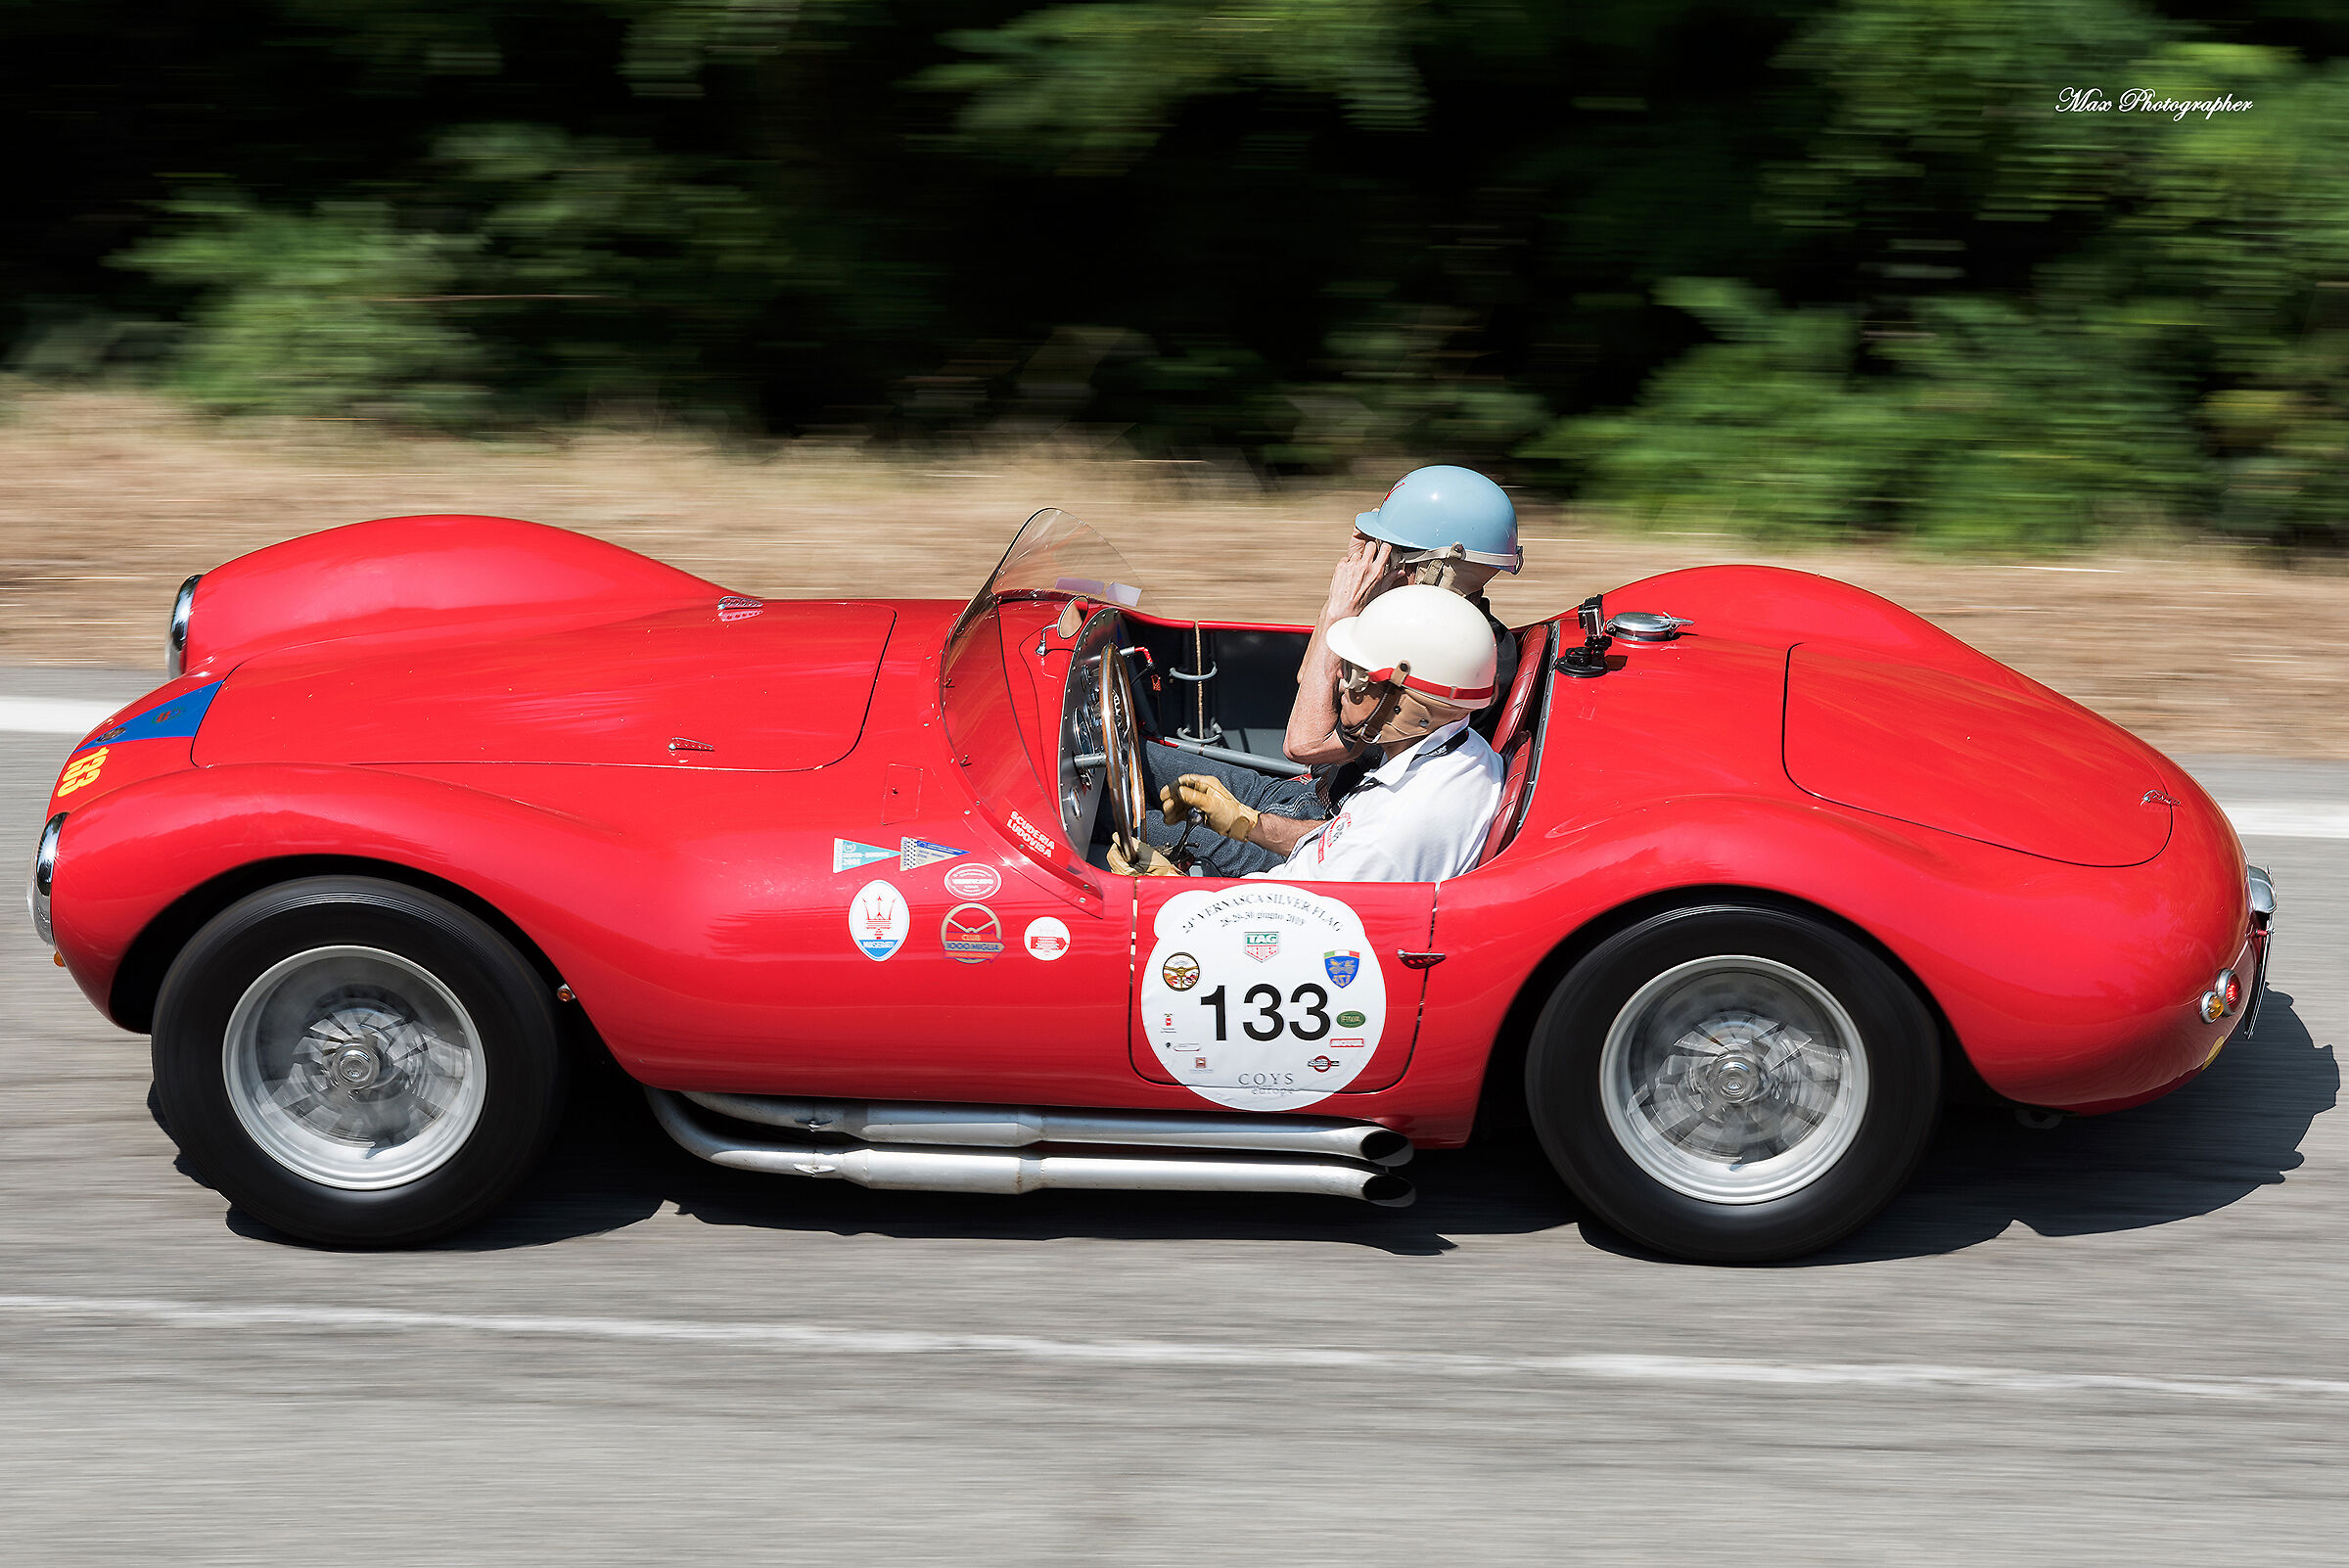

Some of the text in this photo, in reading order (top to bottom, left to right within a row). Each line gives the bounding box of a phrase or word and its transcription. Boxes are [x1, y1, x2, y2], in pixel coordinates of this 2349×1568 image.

[57, 747, 110, 798] 133
[1010, 810, 1055, 850] SCUDERIA
[1197, 893, 1265, 919] VERNASCA
[1266, 893, 1311, 912] SILVER
[1312, 906, 1344, 932] FLAG
[1247, 933, 1277, 944] TAG
[1200, 982, 1331, 1042] 133
[1237, 1073, 1294, 1085] COYS
